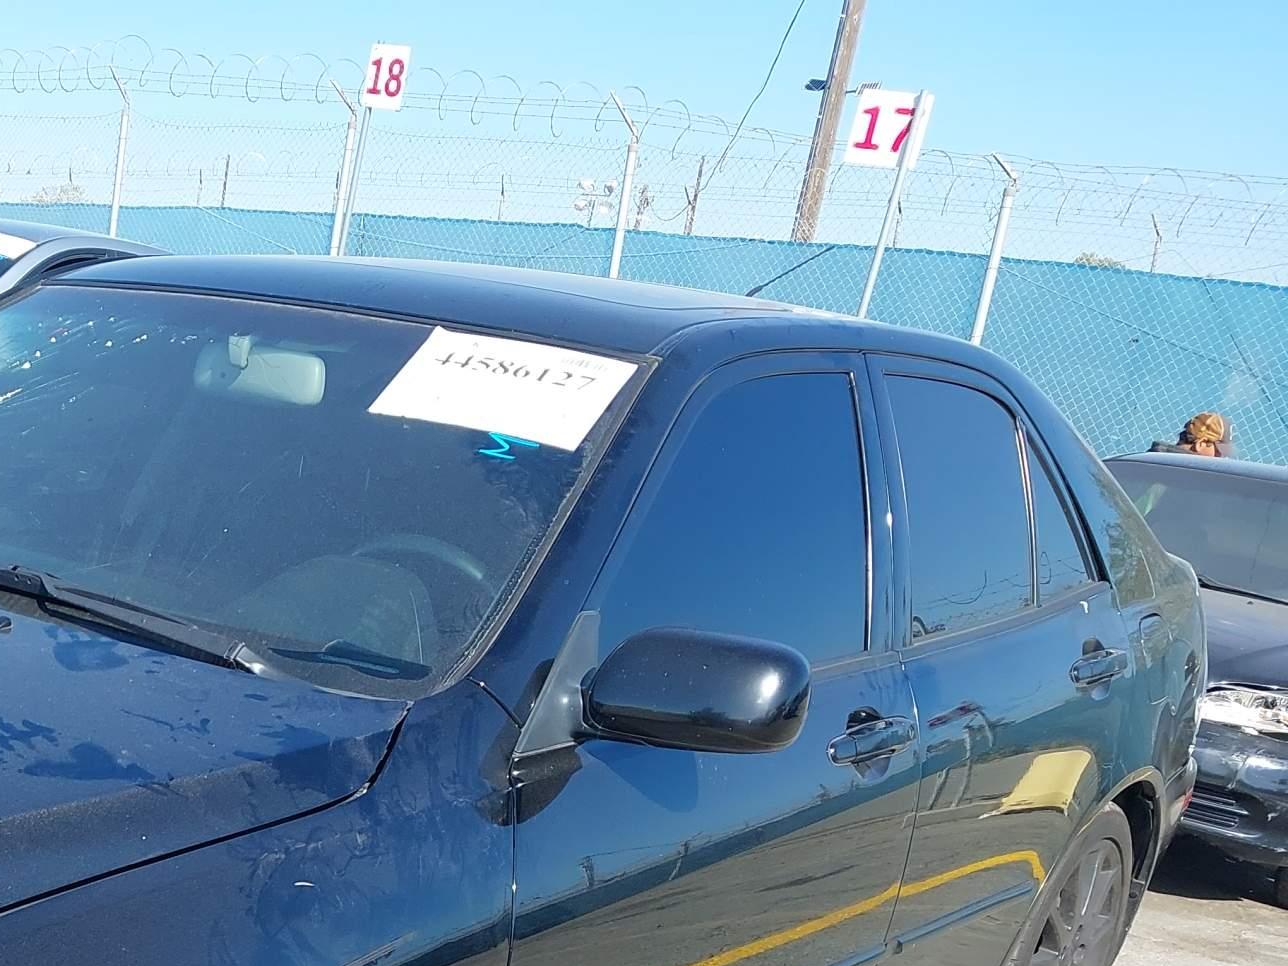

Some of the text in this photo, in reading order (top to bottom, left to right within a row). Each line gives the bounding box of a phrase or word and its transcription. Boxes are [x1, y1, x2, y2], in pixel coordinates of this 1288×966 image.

[366, 53, 405, 98] 18
[852, 106, 916, 153] 17
[434, 351, 597, 391] 44586127
